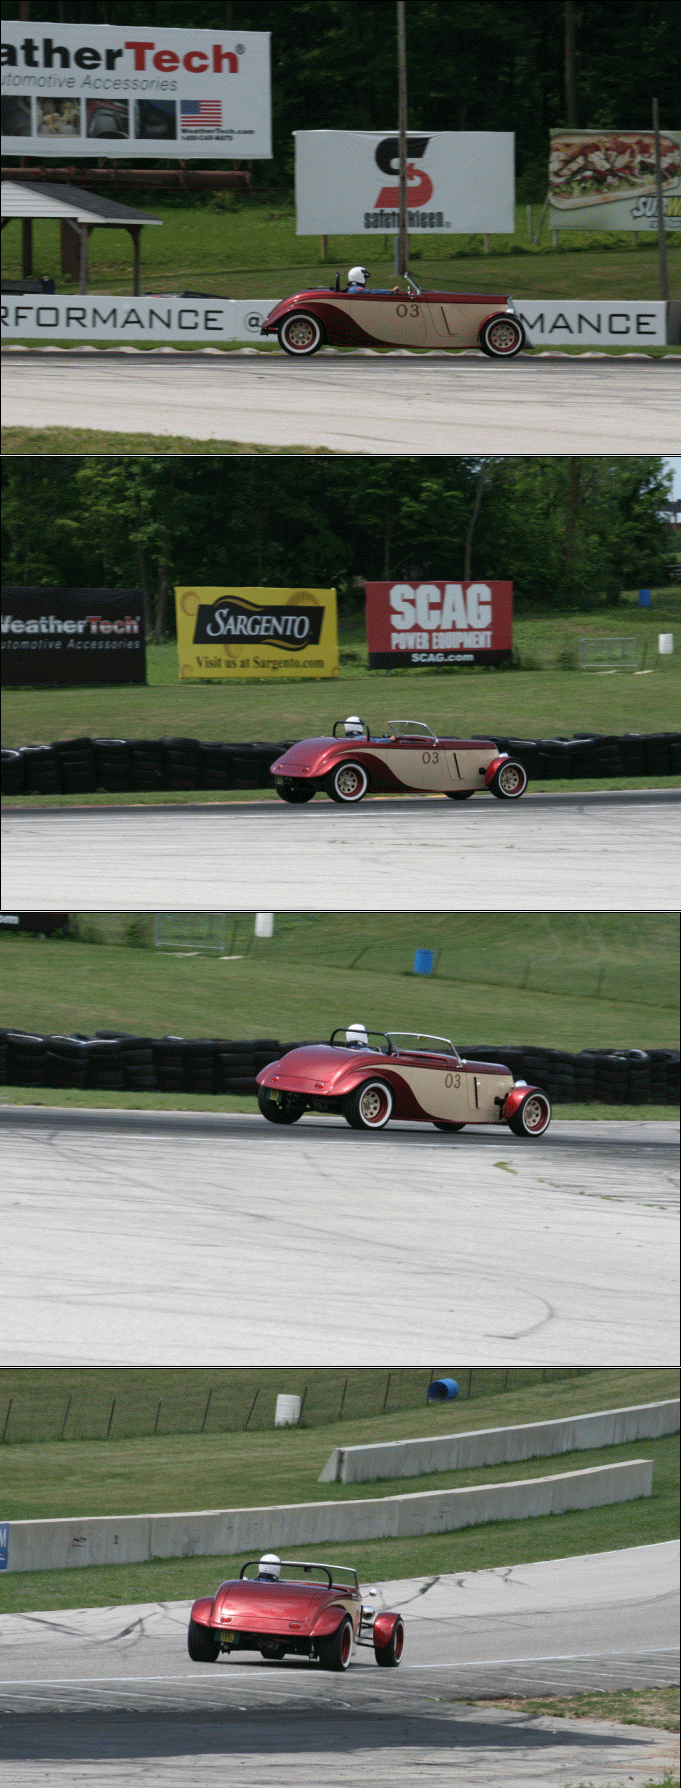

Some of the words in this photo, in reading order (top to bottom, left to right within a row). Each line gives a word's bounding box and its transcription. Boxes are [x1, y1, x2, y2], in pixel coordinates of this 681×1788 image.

[80, 75, 178, 91] Accessories
[396, 303, 420, 318] 03
[389, 583, 492, 630] SCAG
[206, 608, 310, 639] SARGENTO
[67, 639, 140, 650] Accessories
[391, 632, 430, 650] POWER
[432, 631, 493, 650] EQUIPMENT
[195, 656, 221, 668] Visit
[225, 660, 236, 668] us
[240, 659, 250, 668] at
[253, 656, 325, 671] Sargento.com
[411, 653, 475, 662] SCAG.com
[422, 751, 439, 764] 03
[445, 1073, 461, 1088] 03
